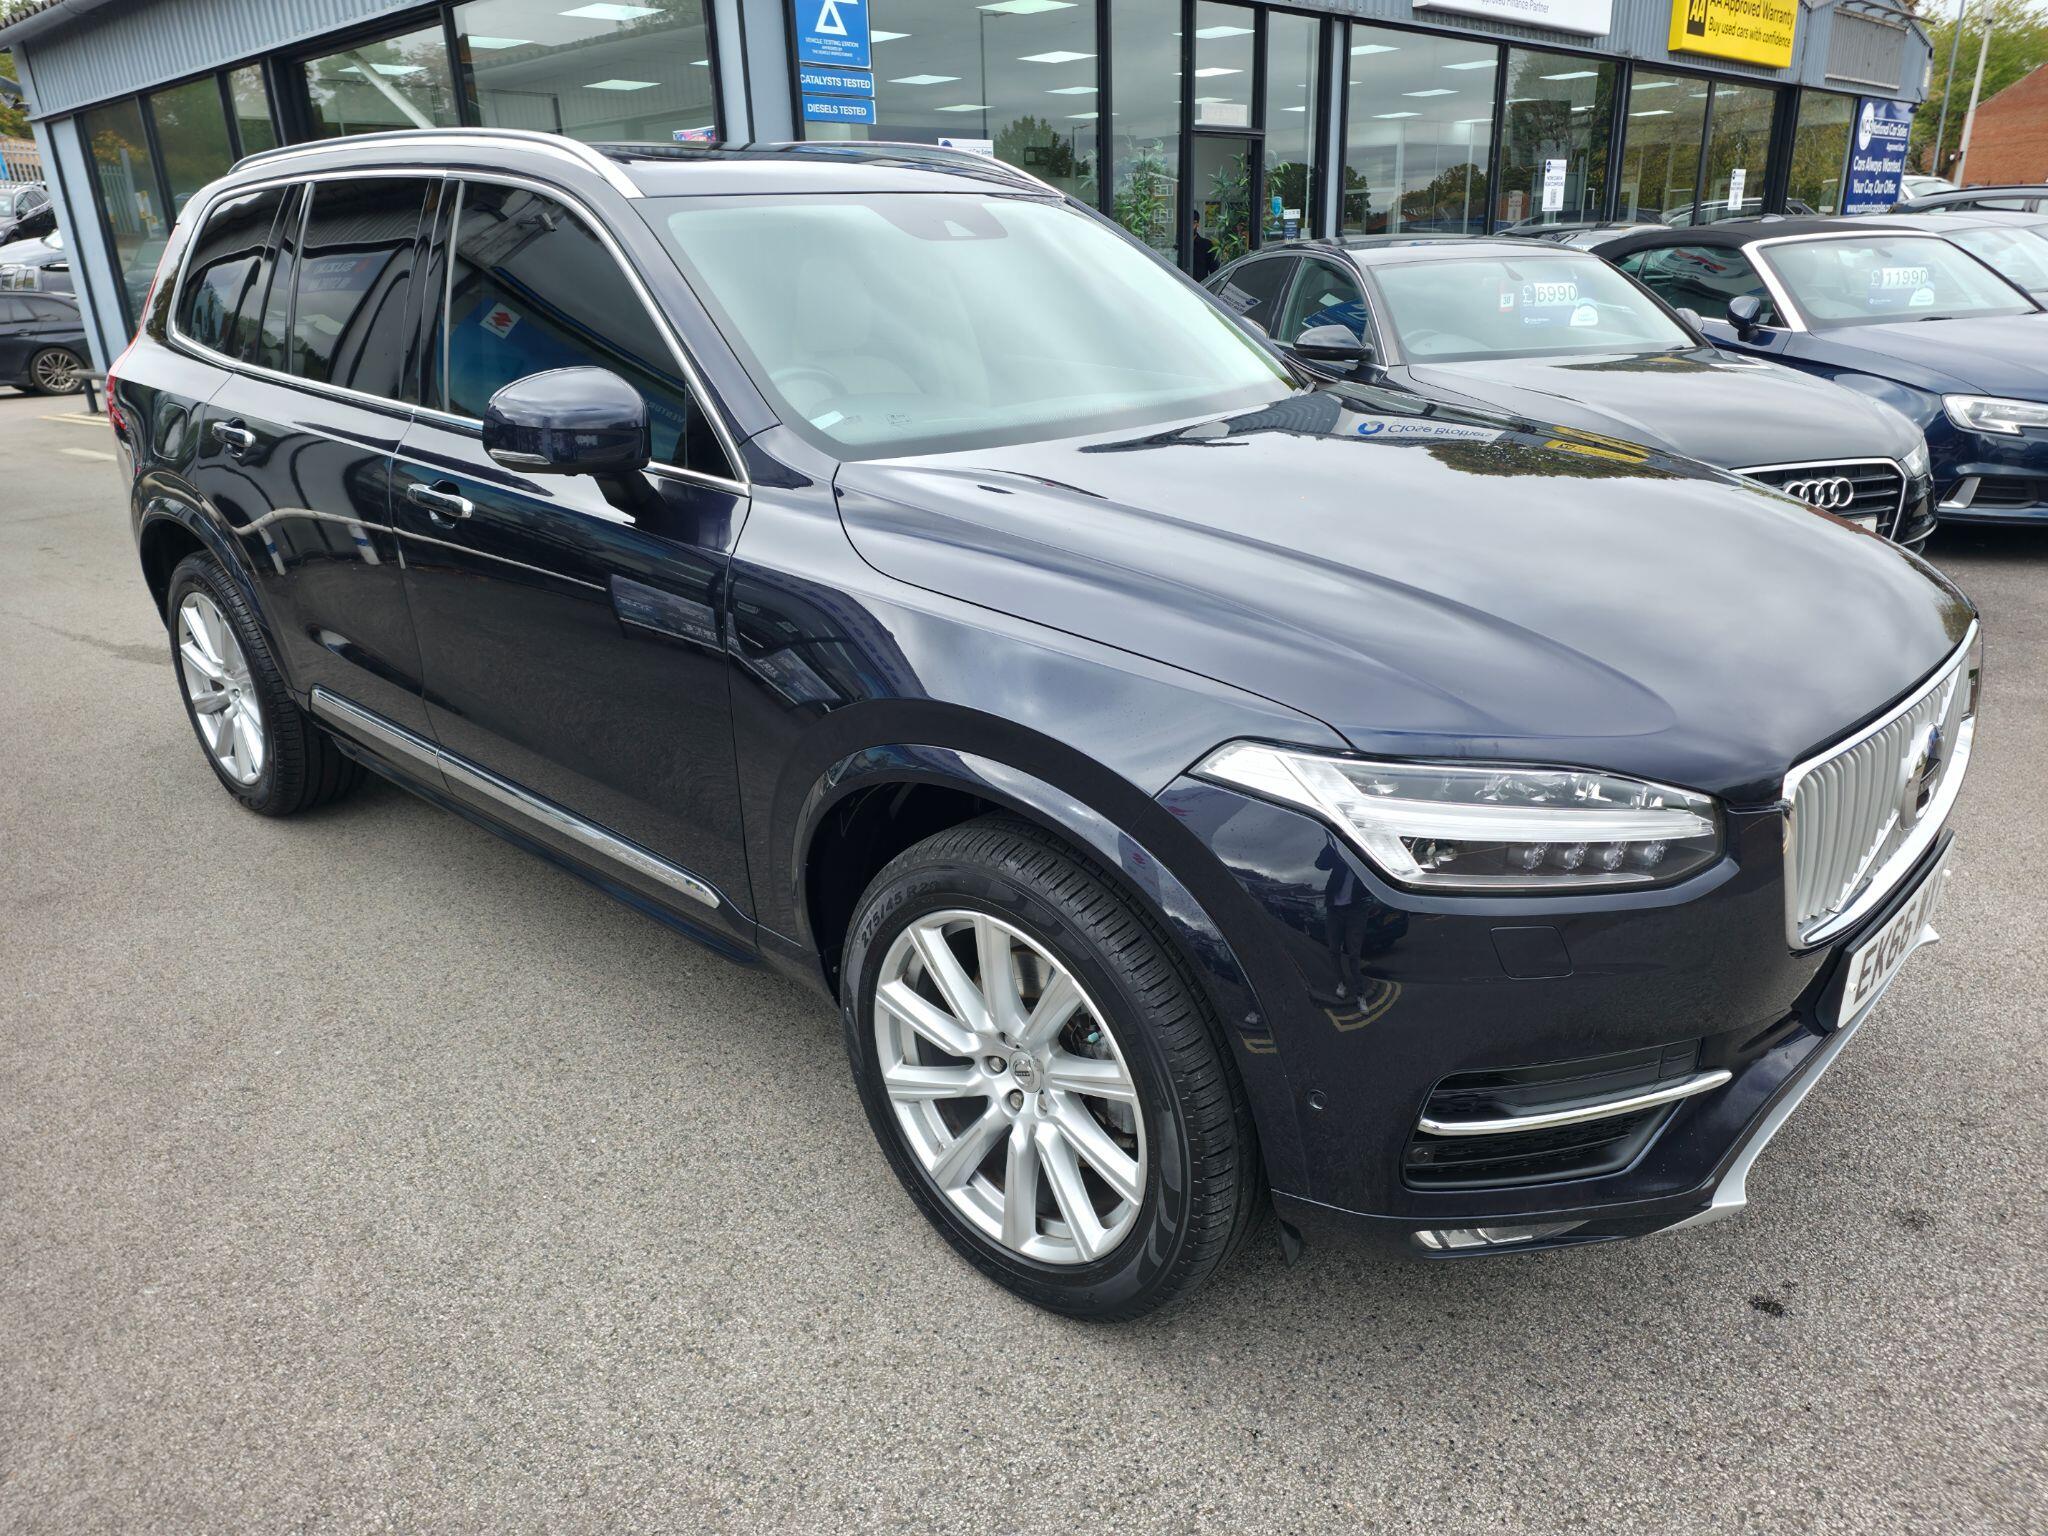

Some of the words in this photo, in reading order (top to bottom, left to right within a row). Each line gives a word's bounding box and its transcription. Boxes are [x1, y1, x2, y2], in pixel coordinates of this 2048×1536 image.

[1530, 0, 1549, 14] Partner
[1689, 0, 1706, 23] AA
[1724, 0, 1761, 17] Approved
[1762, 2, 1795, 30] Warranty
[1708, 17, 1720, 36] Buy
[1721, 22, 1735, 36] used
[1736, 25, 1749, 40] cars
[1749, 27, 1762, 42] with
[1762, 31, 1791, 48] confidence
[800, 75, 842, 87] CATALYSTS
[842, 78, 871, 88] TESTED
[807, 104, 839, 114] DIESELS
[839, 105, 867, 115] TESTED
[1889, 123, 1898, 136] Car
[1897, 124, 1908, 137] Sales
[1853, 156, 1866, 171] Cars
[1865, 156, 1882, 175] Always
[1882, 158, 1902, 173] Wanted.
[1853, 179, 1864, 194] Your
[1874, 179, 1884, 194] Our
[1523, 285, 1577, 303] £6990
[862, 890, 902, 948] 275/45
